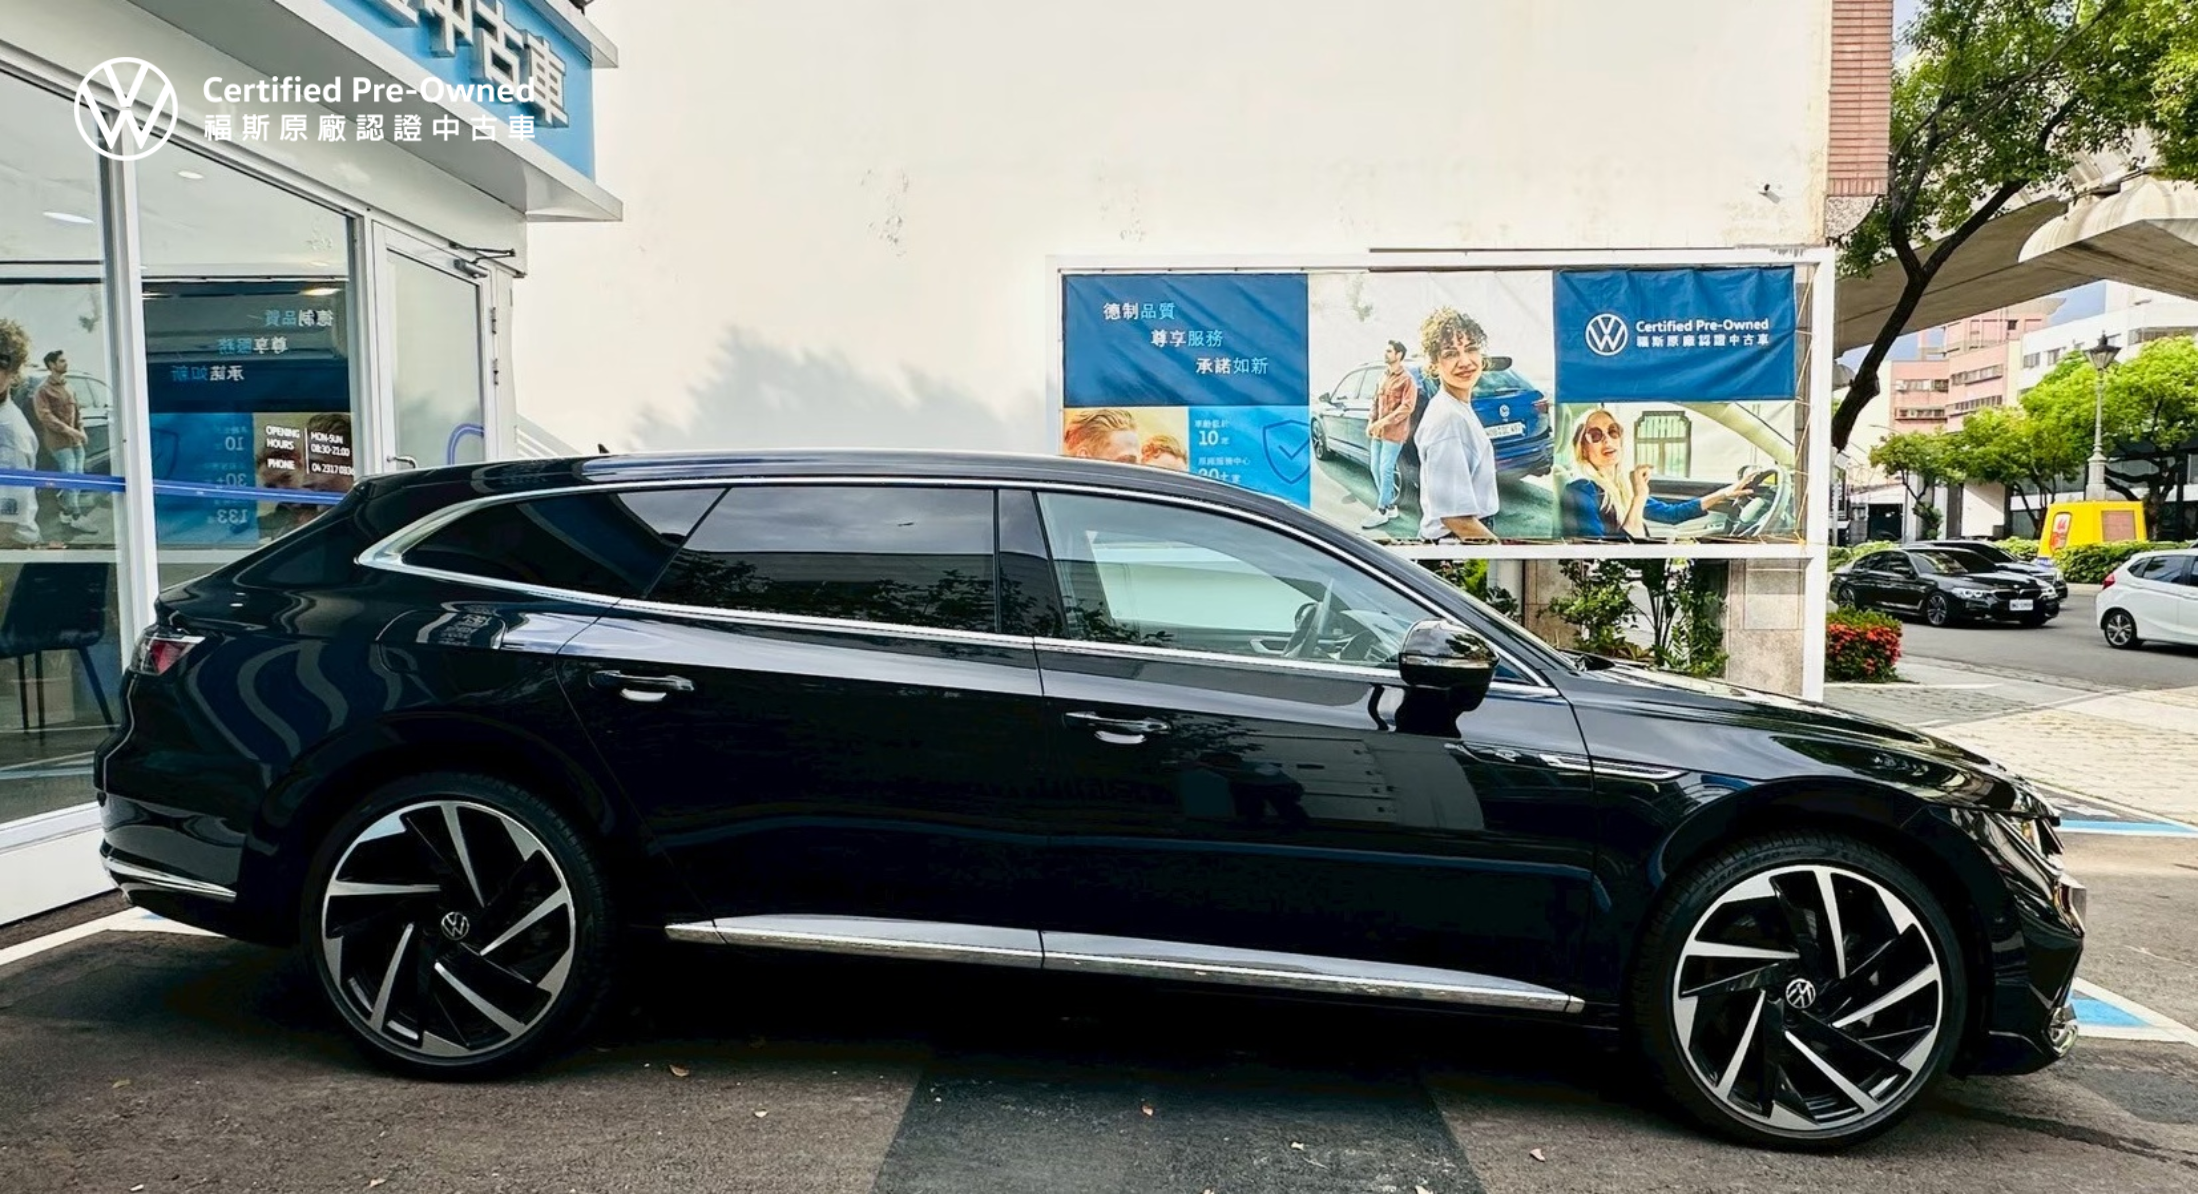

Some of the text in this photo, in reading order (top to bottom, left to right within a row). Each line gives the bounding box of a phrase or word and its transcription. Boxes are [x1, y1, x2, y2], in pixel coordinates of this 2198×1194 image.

[1103, 302, 1176, 320] 德制品質
[1636, 318, 1769, 333] Certified Pre-Owned
[1151, 329, 1223, 348] 尊享服務
[1636, 334, 1769, 348] 福斯原廠認證中古車
[1196, 357, 1269, 375] 承諾如新
[266, 425, 300, 439] OPENING
[1198, 430, 1219, 446] 10
[267, 438, 295, 450] HOURS
[268, 459, 295, 470] PHONE
